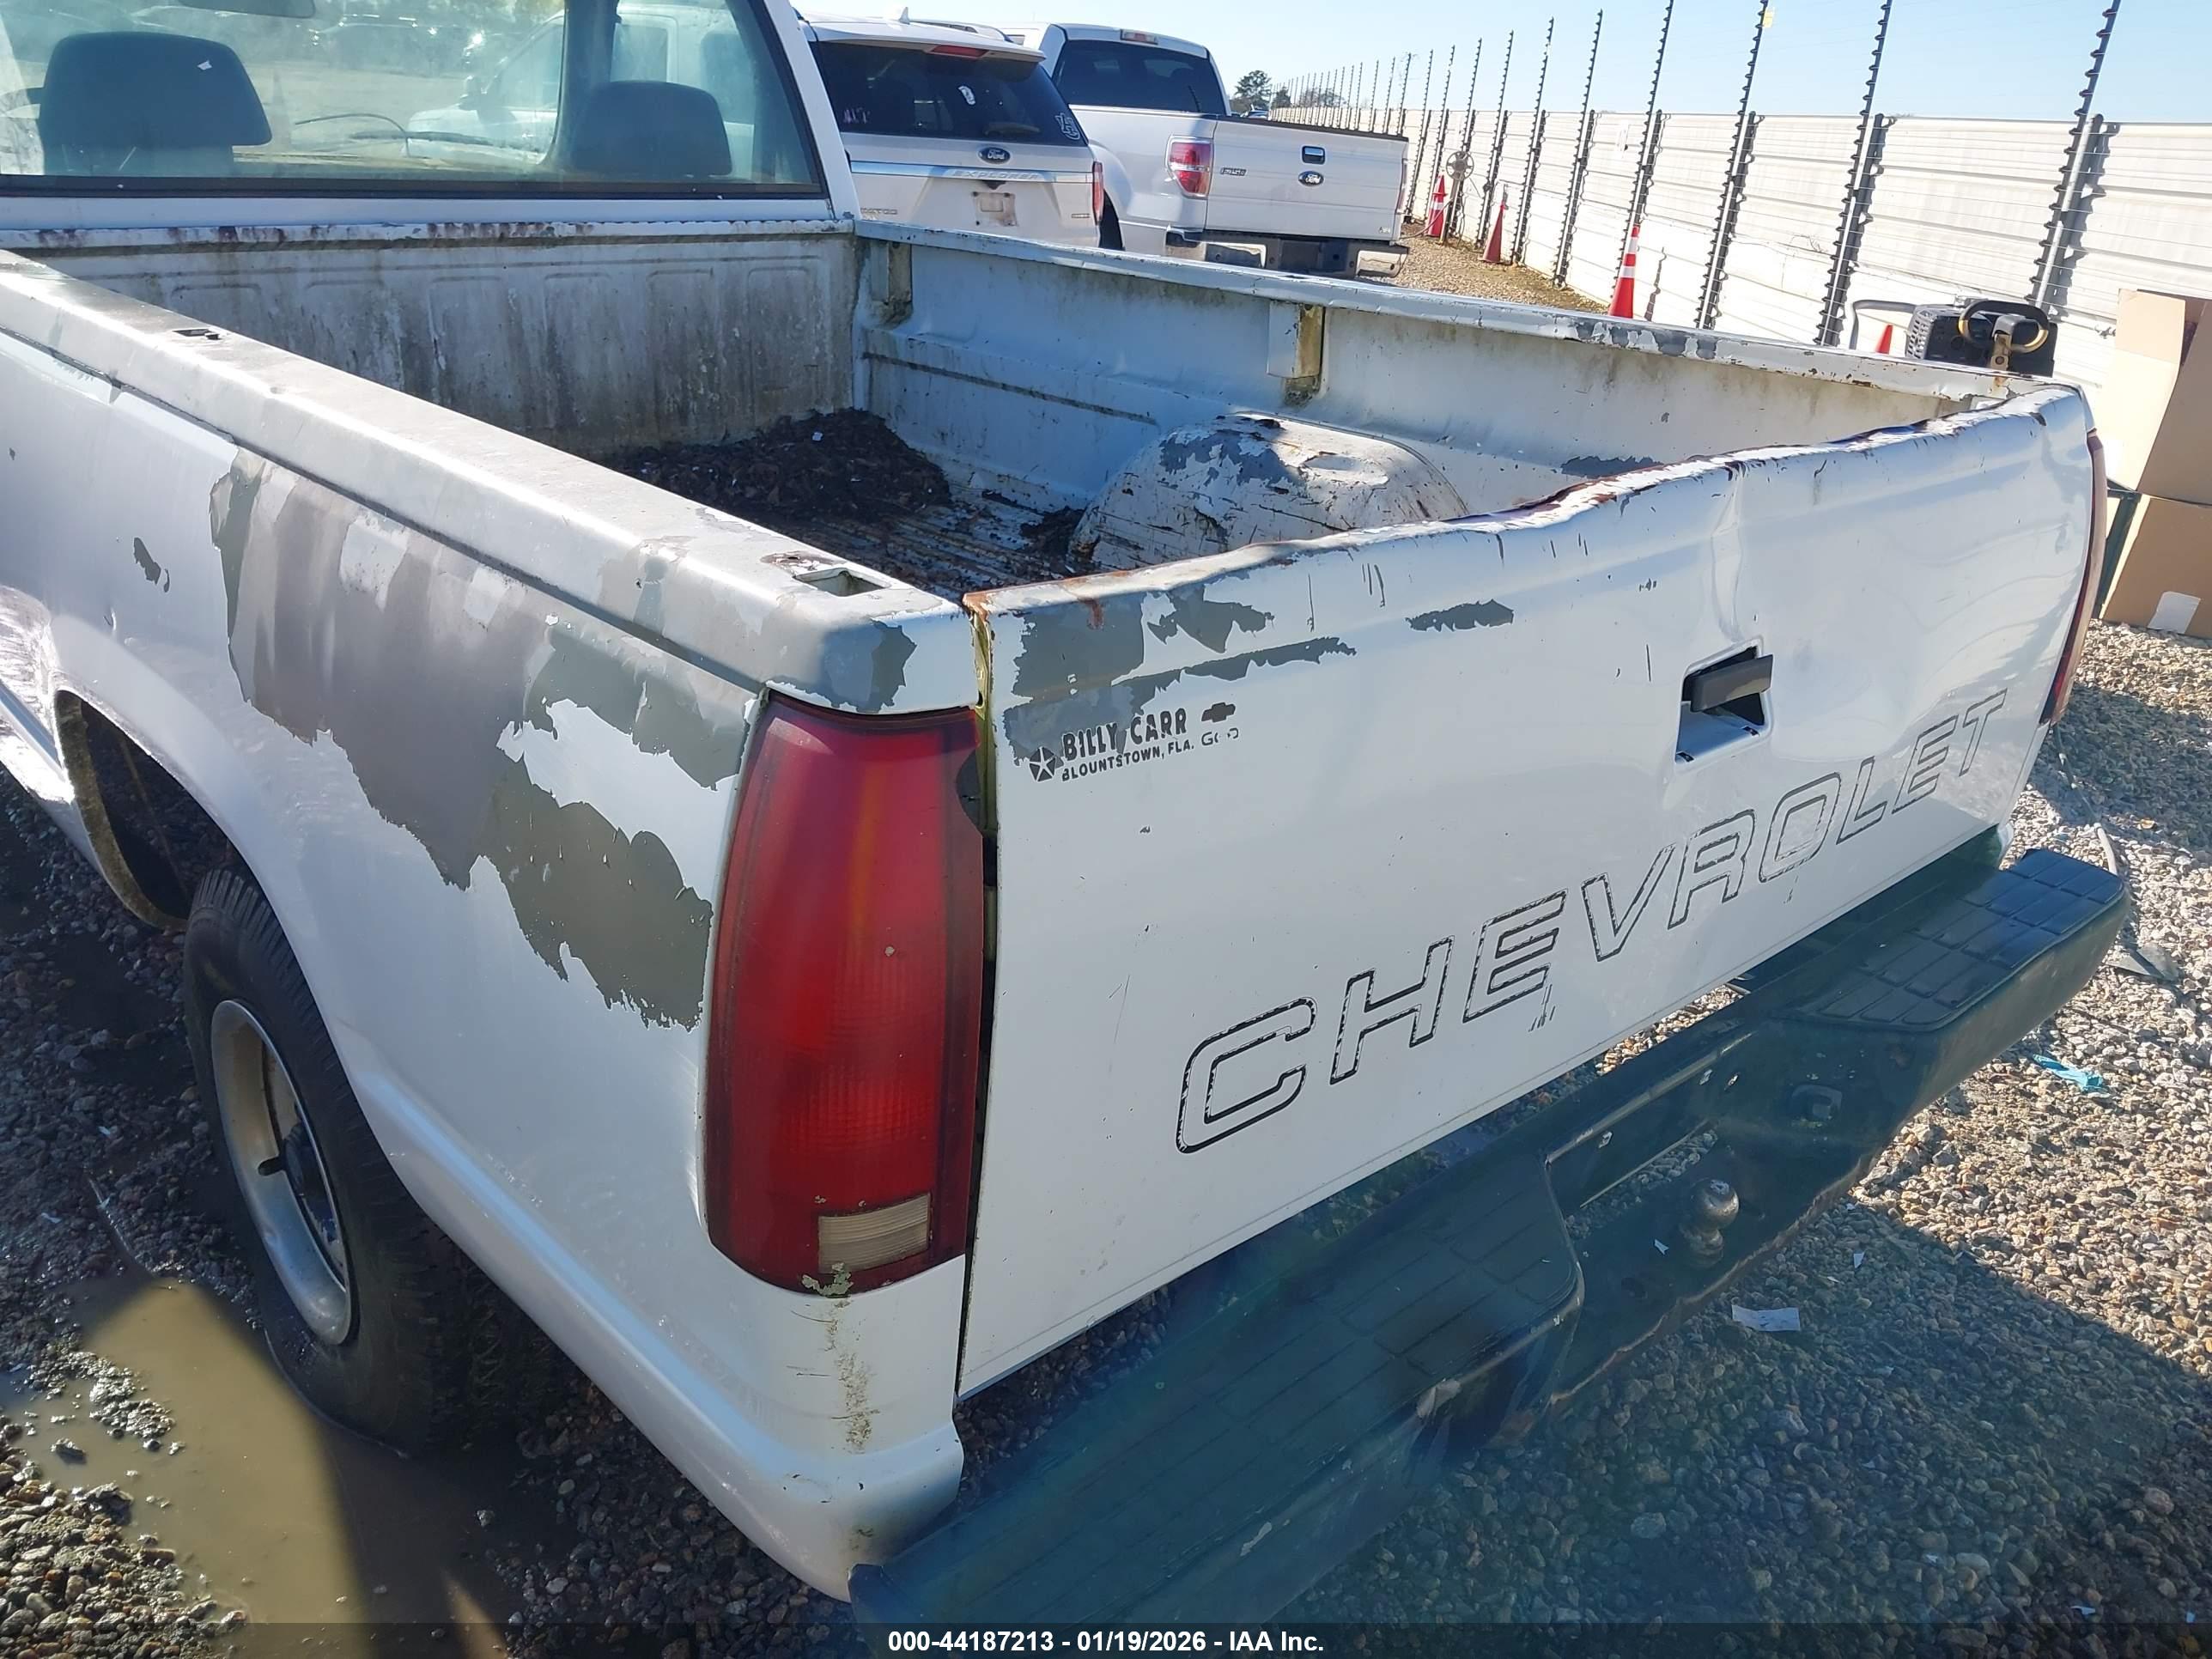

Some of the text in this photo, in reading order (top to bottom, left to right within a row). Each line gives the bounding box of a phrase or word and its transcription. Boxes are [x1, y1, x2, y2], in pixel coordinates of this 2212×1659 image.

[953, 170, 1039, 179] EXPLORER
[1062, 708, 1187, 762] BILLY CARR
[1061, 739, 1194, 782] BLOUNTSTOWN, FLA.
[1175, 687, 2009, 1155] CHEVROLET
